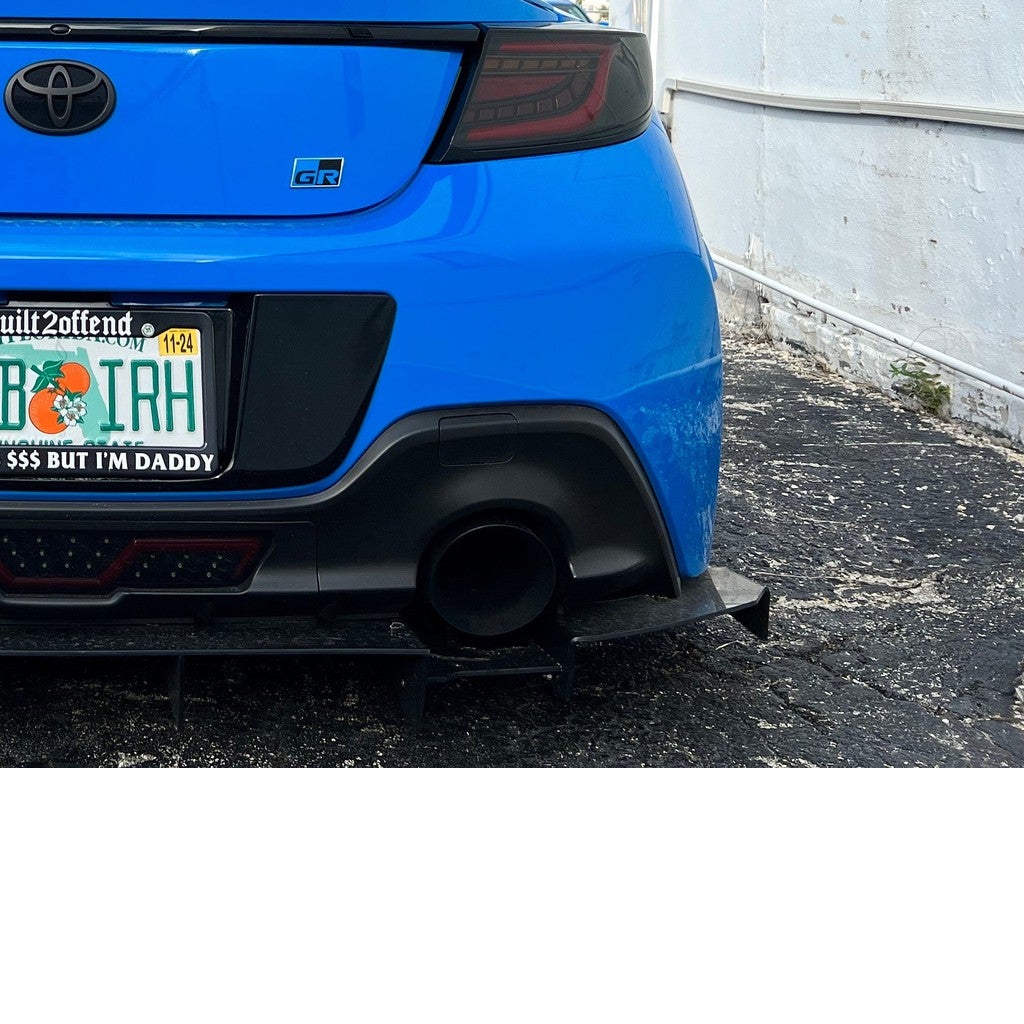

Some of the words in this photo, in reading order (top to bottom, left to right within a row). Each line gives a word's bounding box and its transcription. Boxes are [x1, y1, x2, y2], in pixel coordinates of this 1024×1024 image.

[295, 169, 340, 185] GR
[98, 359, 197, 433] IRH
[6, 449, 41, 470] $$$
[47, 451, 89, 469] BUT
[95, 451, 128, 471] I'M
[134, 452, 215, 472] DADDY
